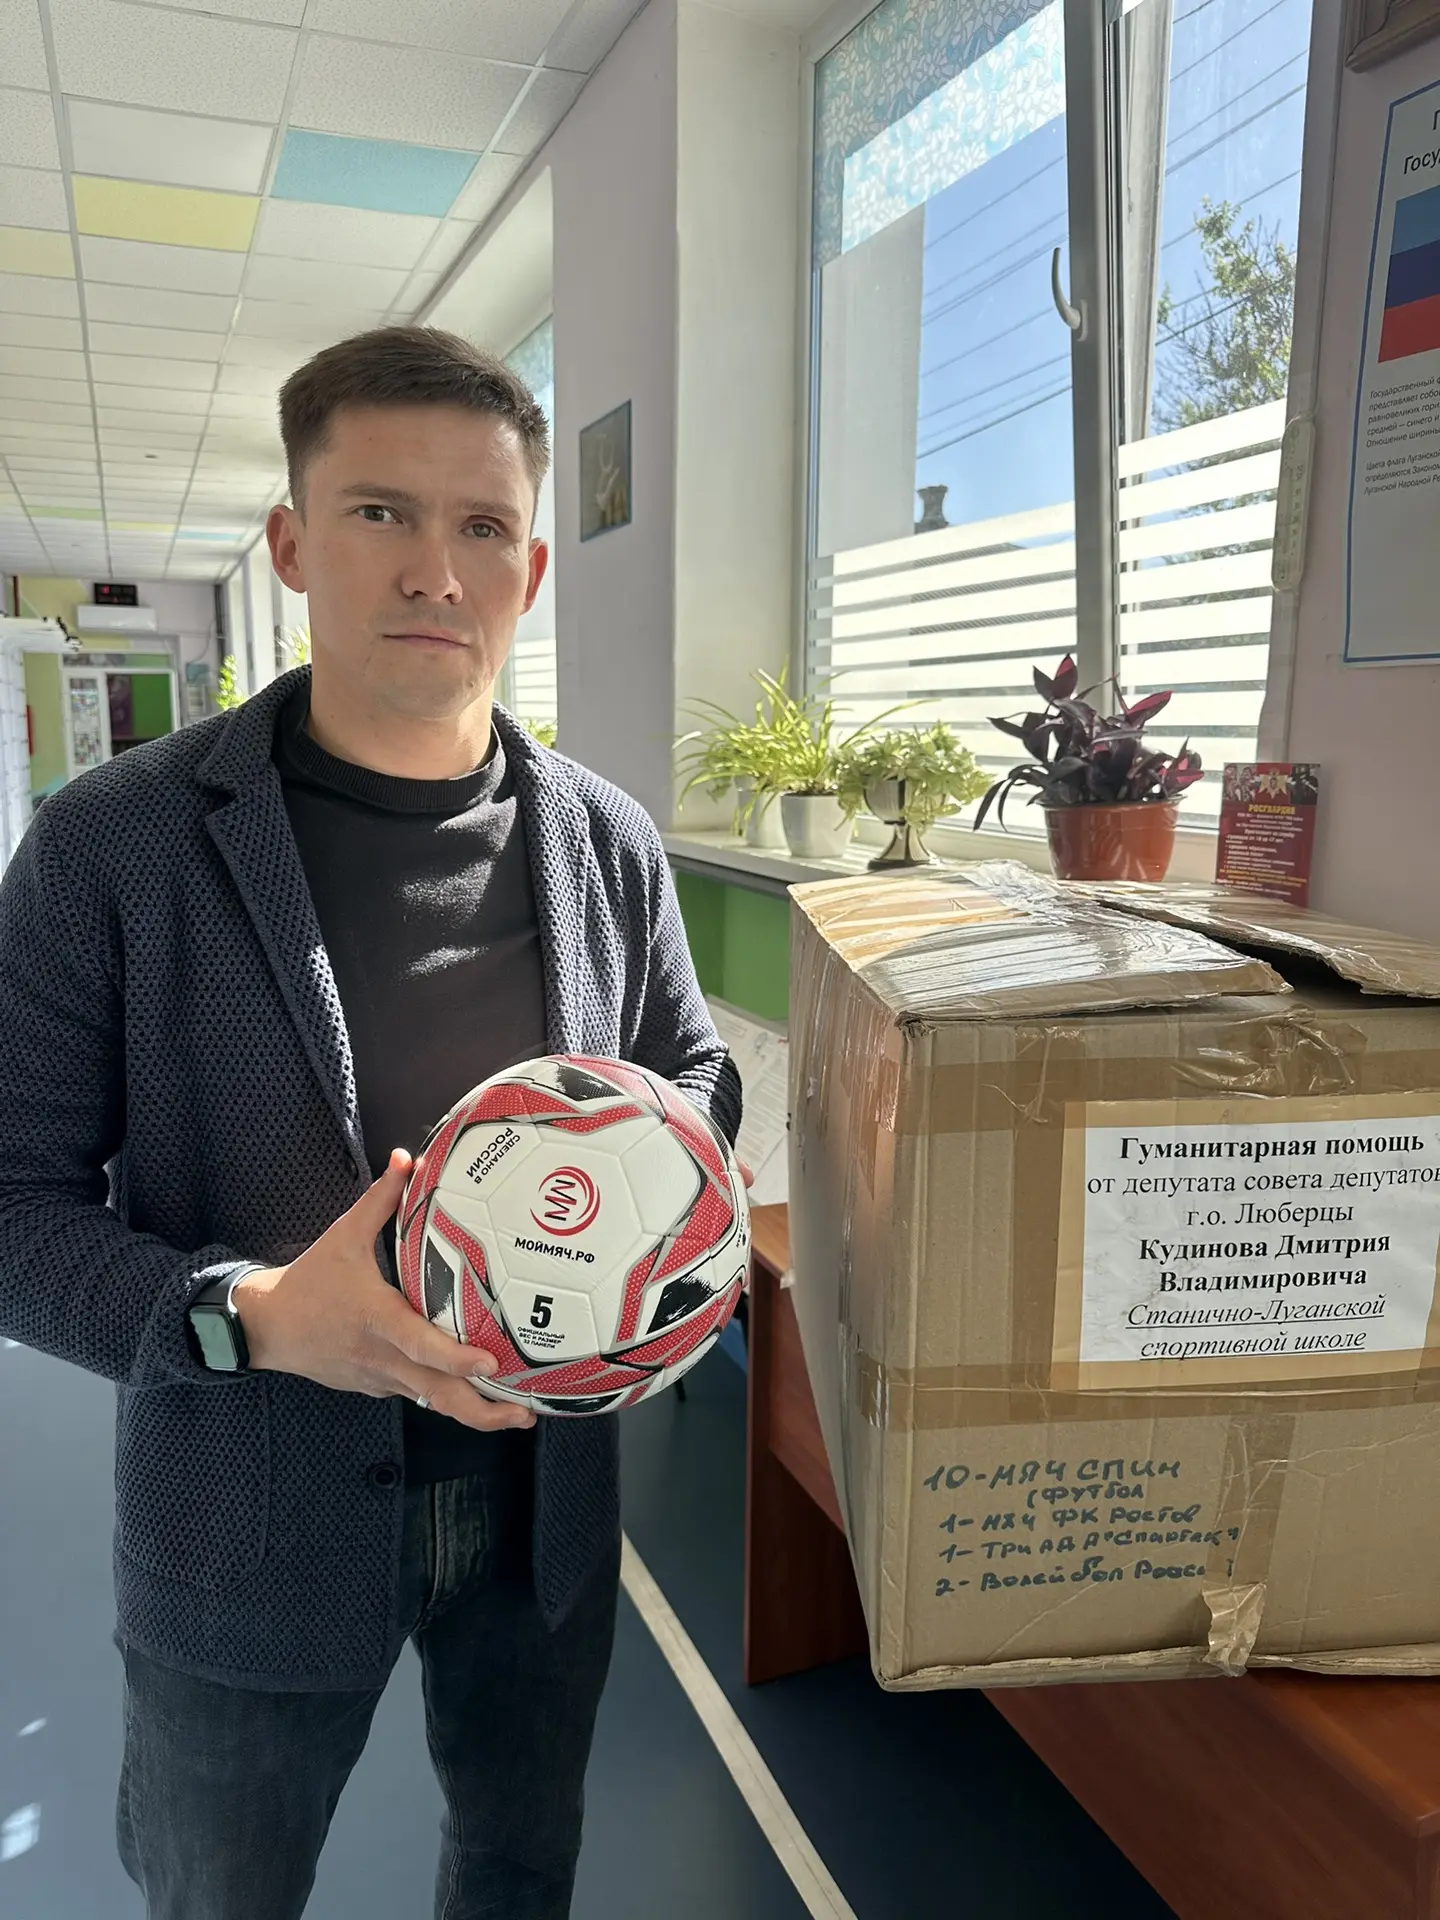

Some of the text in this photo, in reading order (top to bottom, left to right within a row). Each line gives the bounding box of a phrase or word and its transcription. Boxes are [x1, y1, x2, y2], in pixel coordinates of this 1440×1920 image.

[1404, 148, 1440, 175] Госу
[1370, 376, 1435, 399] Государственный
[1369, 394, 1418, 412] представляет
[1367, 422, 1397, 436] средней
[1406, 416, 1433, 427] синего
[1366, 433, 1408, 449] Отношение
[1366, 461, 1386, 471] Цвета
[1363, 481, 1397, 496] Луганской
[1398, 476, 1431, 489] Народной
[466, 1127, 514, 1178] РОССИИ
[474, 1134, 521, 1185] СДЕЛАНО В
[1119, 1136, 1425, 1164] Гуманитарная помощь
[1087, 1177, 1116, 1194] от
[1123, 1174, 1236, 1197] депутата
[1244, 1173, 1323, 1191] совета
[1186, 1203, 1354, 1227] г.о. Люберцы
[514, 1237, 595, 1264] МОЙМЯЧ.РФ
[1139, 1235, 1391, 1265] Кудинова Дмитрия
[1160, 1267, 1367, 1293] Владимировича
[530, 1294, 554, 1329] 5
[1126, 1295, 1386, 1327] Станично-Луганской
[517, 1326, 565, 1340] ОФИЦИАЛЬНЫЙ
[531, 1340, 556, 1349] ПАНЕЛИ
[538, 1336, 562, 1344] РАЗМЕР
[1140, 1330, 1367, 1359] спортивной школе
